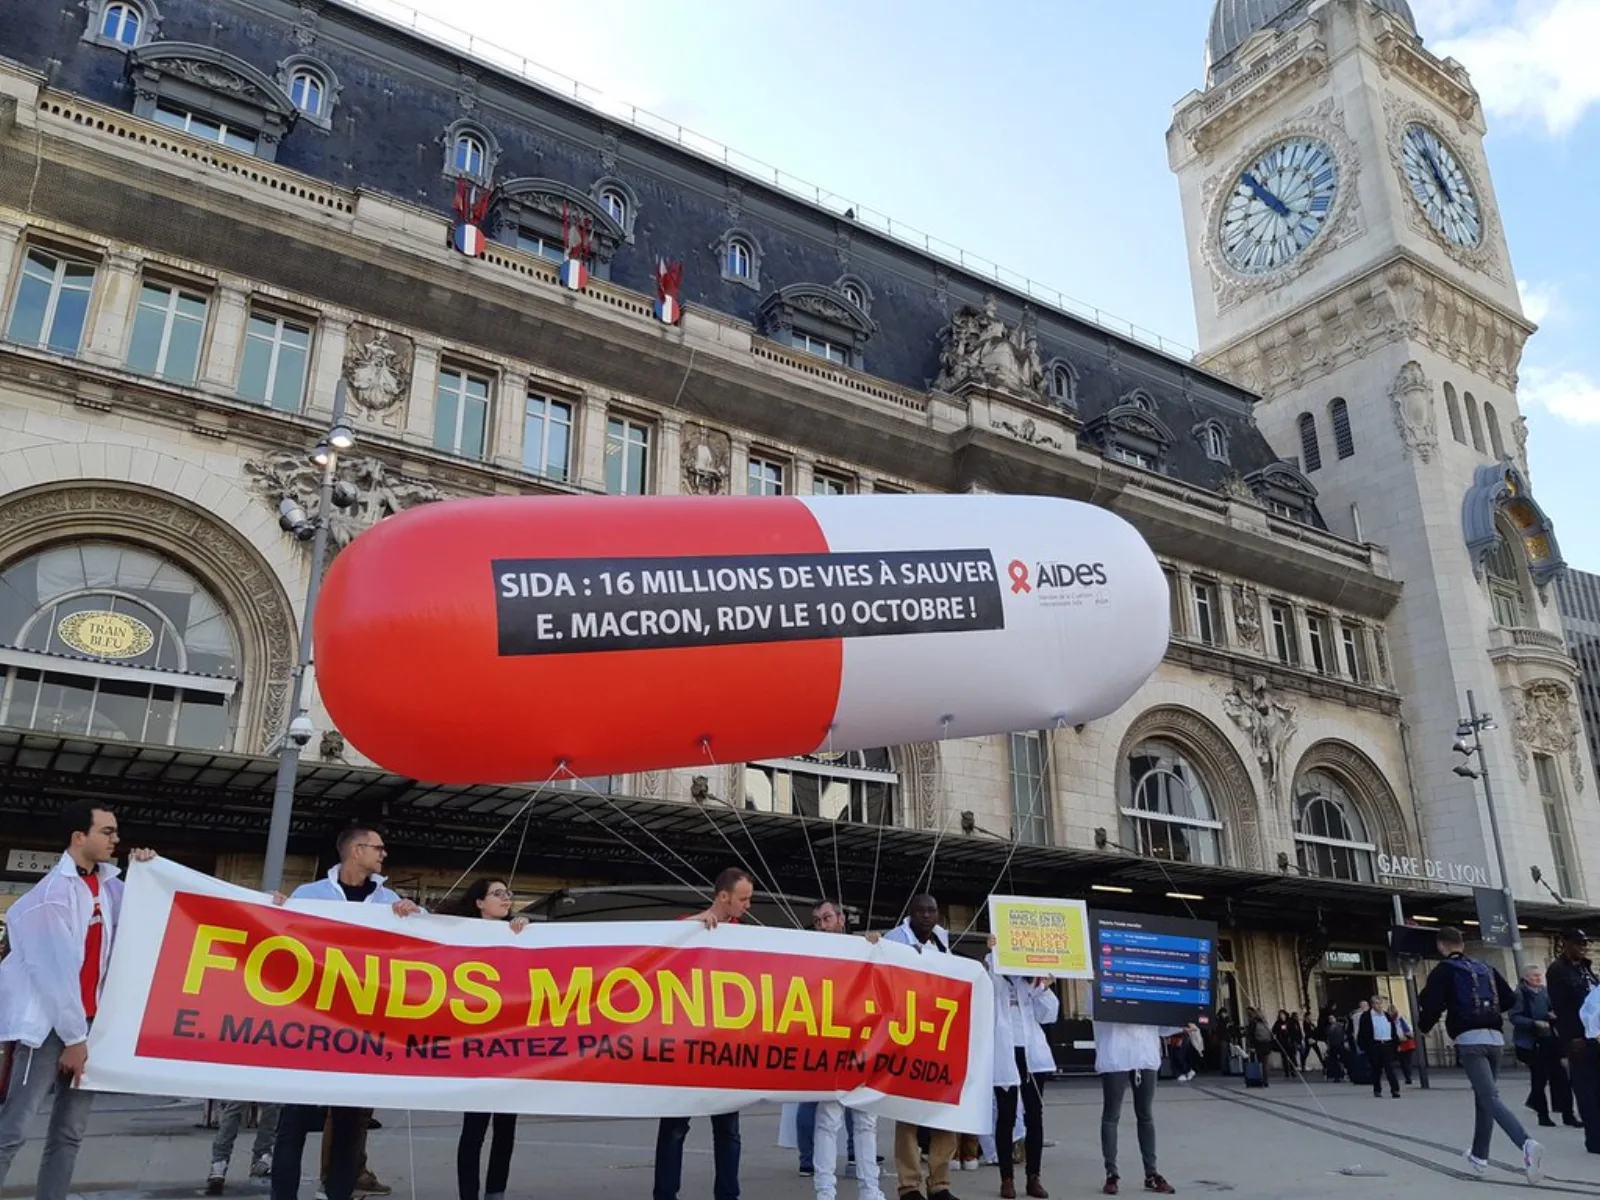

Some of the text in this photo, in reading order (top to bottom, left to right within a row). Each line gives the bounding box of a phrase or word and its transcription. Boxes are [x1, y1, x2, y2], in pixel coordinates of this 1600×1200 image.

[501, 572, 576, 598] SIDA
[600, 571, 635, 595] 16
[642, 567, 774, 594] MILLIONS
[779, 565, 815, 589] DE
[816, 564, 873, 588] VIES
[879, 559, 897, 585] À
[900, 560, 994, 585] SAUVER
[90, 623, 127, 637] TRAIN
[536, 613, 563, 640] E.
[571, 608, 710, 639] MACRON,
[717, 604, 773, 631] RDV
[780, 602, 810, 628] LE
[816, 601, 846, 626] 10
[851, 597, 965, 624] OCTOBRE
[1378, 854, 1488, 885] GARE DE LYON
[182, 923, 503, 1025] FONDS
[526, 966, 851, 1039] MONDIAL
[888, 990, 959, 1052] J-7
[173, 1008, 205, 1039] E.
[219, 1014, 394, 1062] MACRON,
[405, 1033, 451, 1060] NE
[462, 1036, 569, 1059] RATEZ
[579, 1035, 634, 1061] PAS
[642, 1038, 675, 1063] LE
[684, 1040, 759, 1068] TRAIN
[766, 1044, 797, 1071] DE
[803, 1049, 829, 1073] LA
[873, 1053, 908, 1077] DU
[909, 1058, 954, 1086] SIDA.
